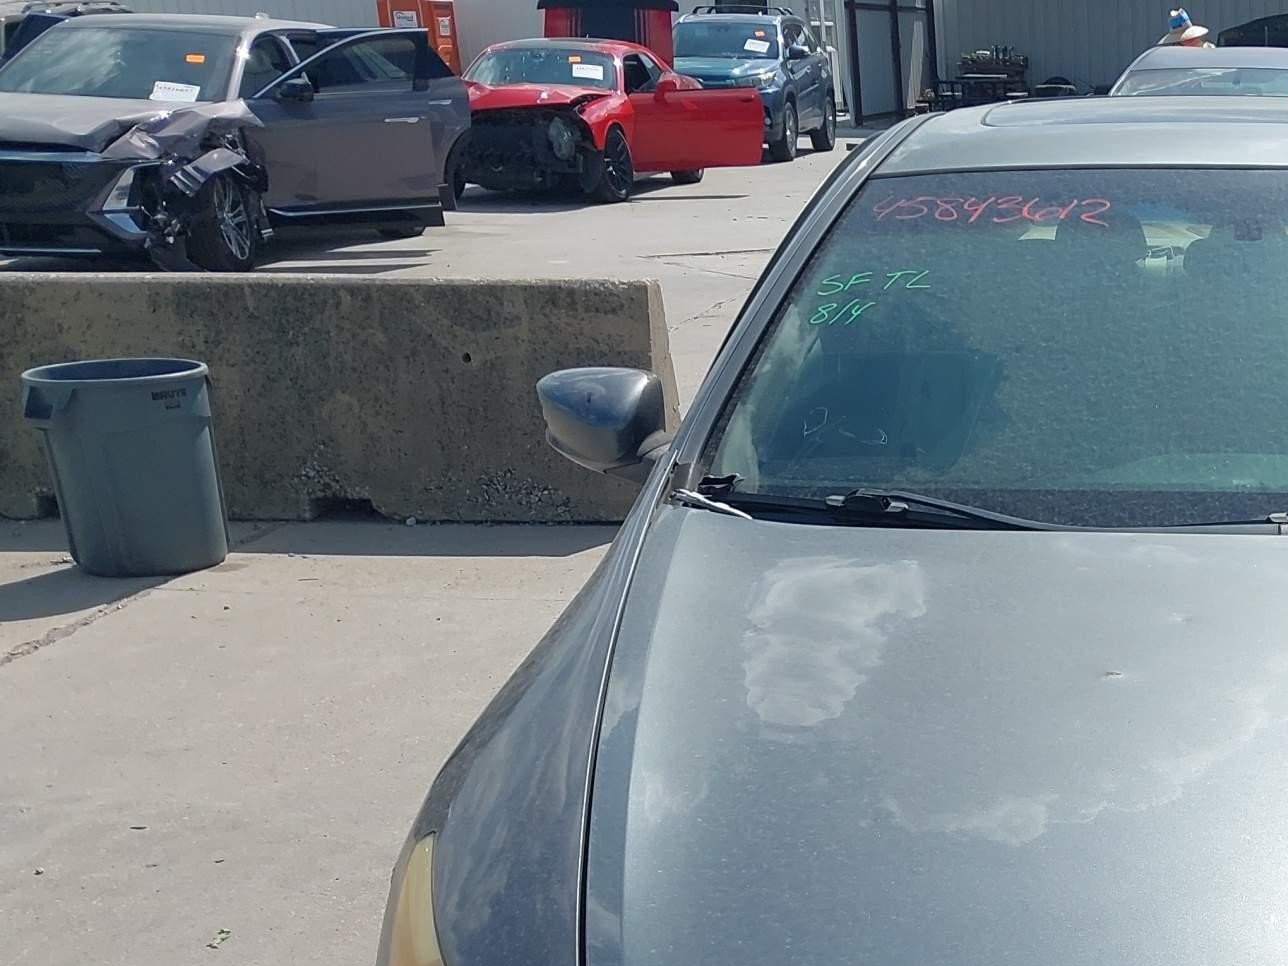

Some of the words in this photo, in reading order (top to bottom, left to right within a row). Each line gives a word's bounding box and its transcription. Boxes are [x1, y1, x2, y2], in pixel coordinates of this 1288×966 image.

[872, 196, 1111, 228] 45843612
[816, 272, 873, 296] SF
[883, 270, 931, 290] TL
[809, 298, 876, 325] 8/4
